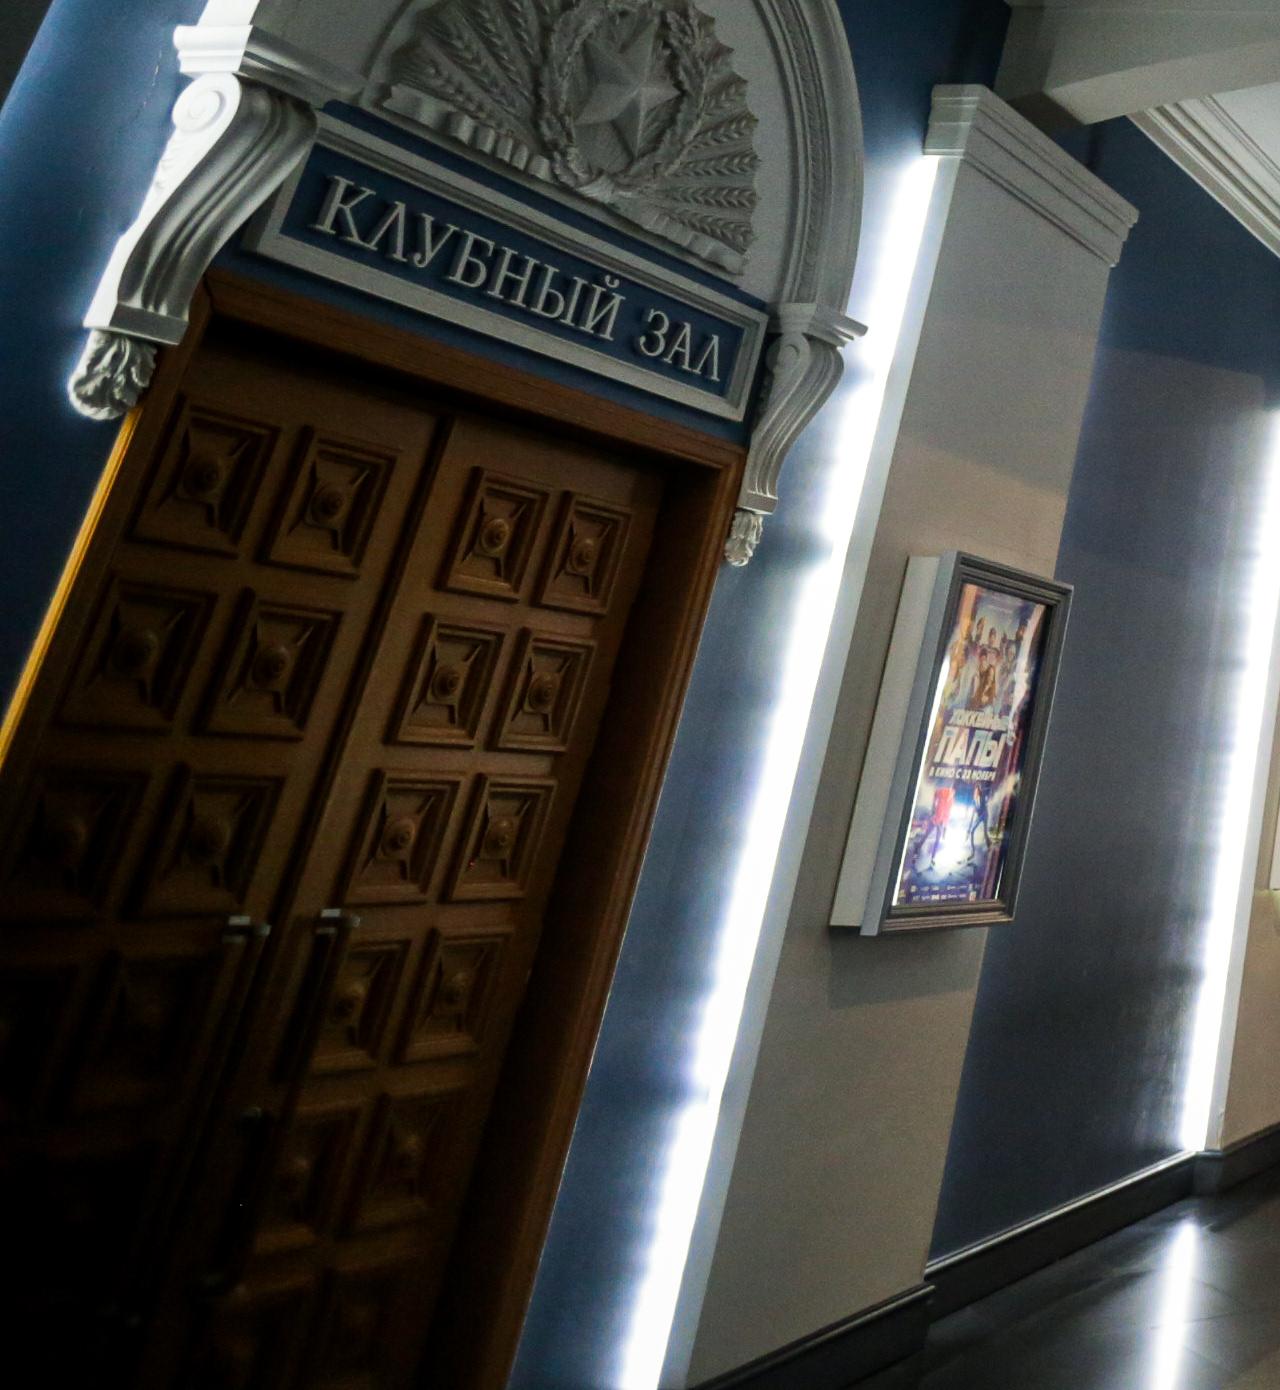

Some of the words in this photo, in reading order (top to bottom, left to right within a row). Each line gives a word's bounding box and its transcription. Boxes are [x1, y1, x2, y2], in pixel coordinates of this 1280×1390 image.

[308, 174, 626, 341] КЛУБНЫЙ
[637, 306, 720, 382] ЗАЛ
[933, 725, 1008, 769] ПАПЫ
